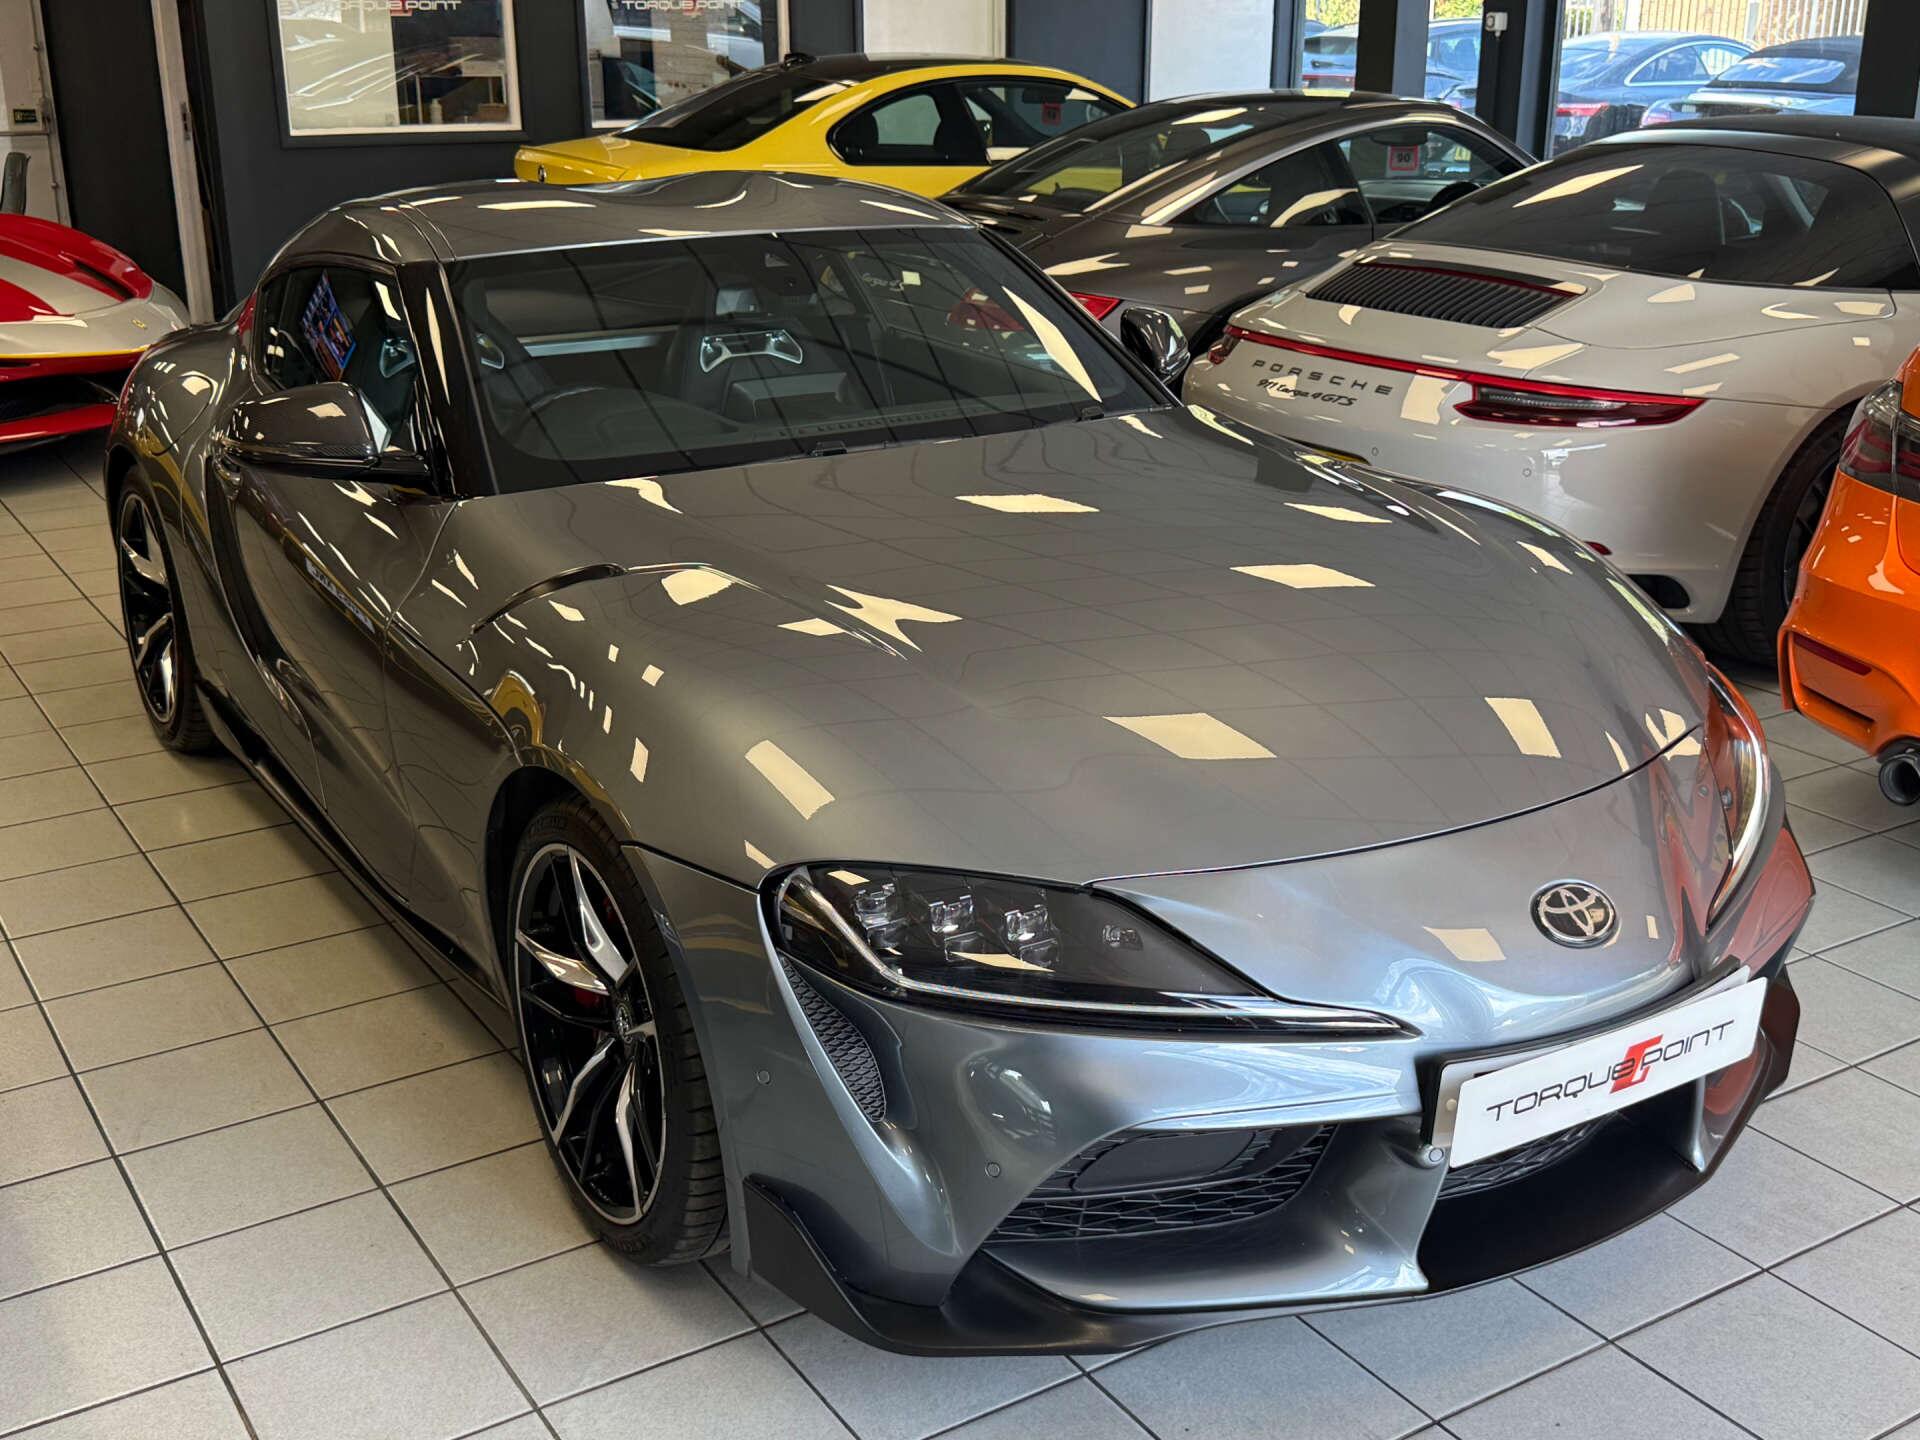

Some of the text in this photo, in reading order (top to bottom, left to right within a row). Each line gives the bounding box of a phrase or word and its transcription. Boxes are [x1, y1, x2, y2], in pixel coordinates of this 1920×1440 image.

[405, 0, 462, 11] POINT
[622, 0, 694, 11] TORQUE
[1252, 359, 1393, 396] PORSCHE
[1486, 1018, 1735, 1122] TORQUE POINT
